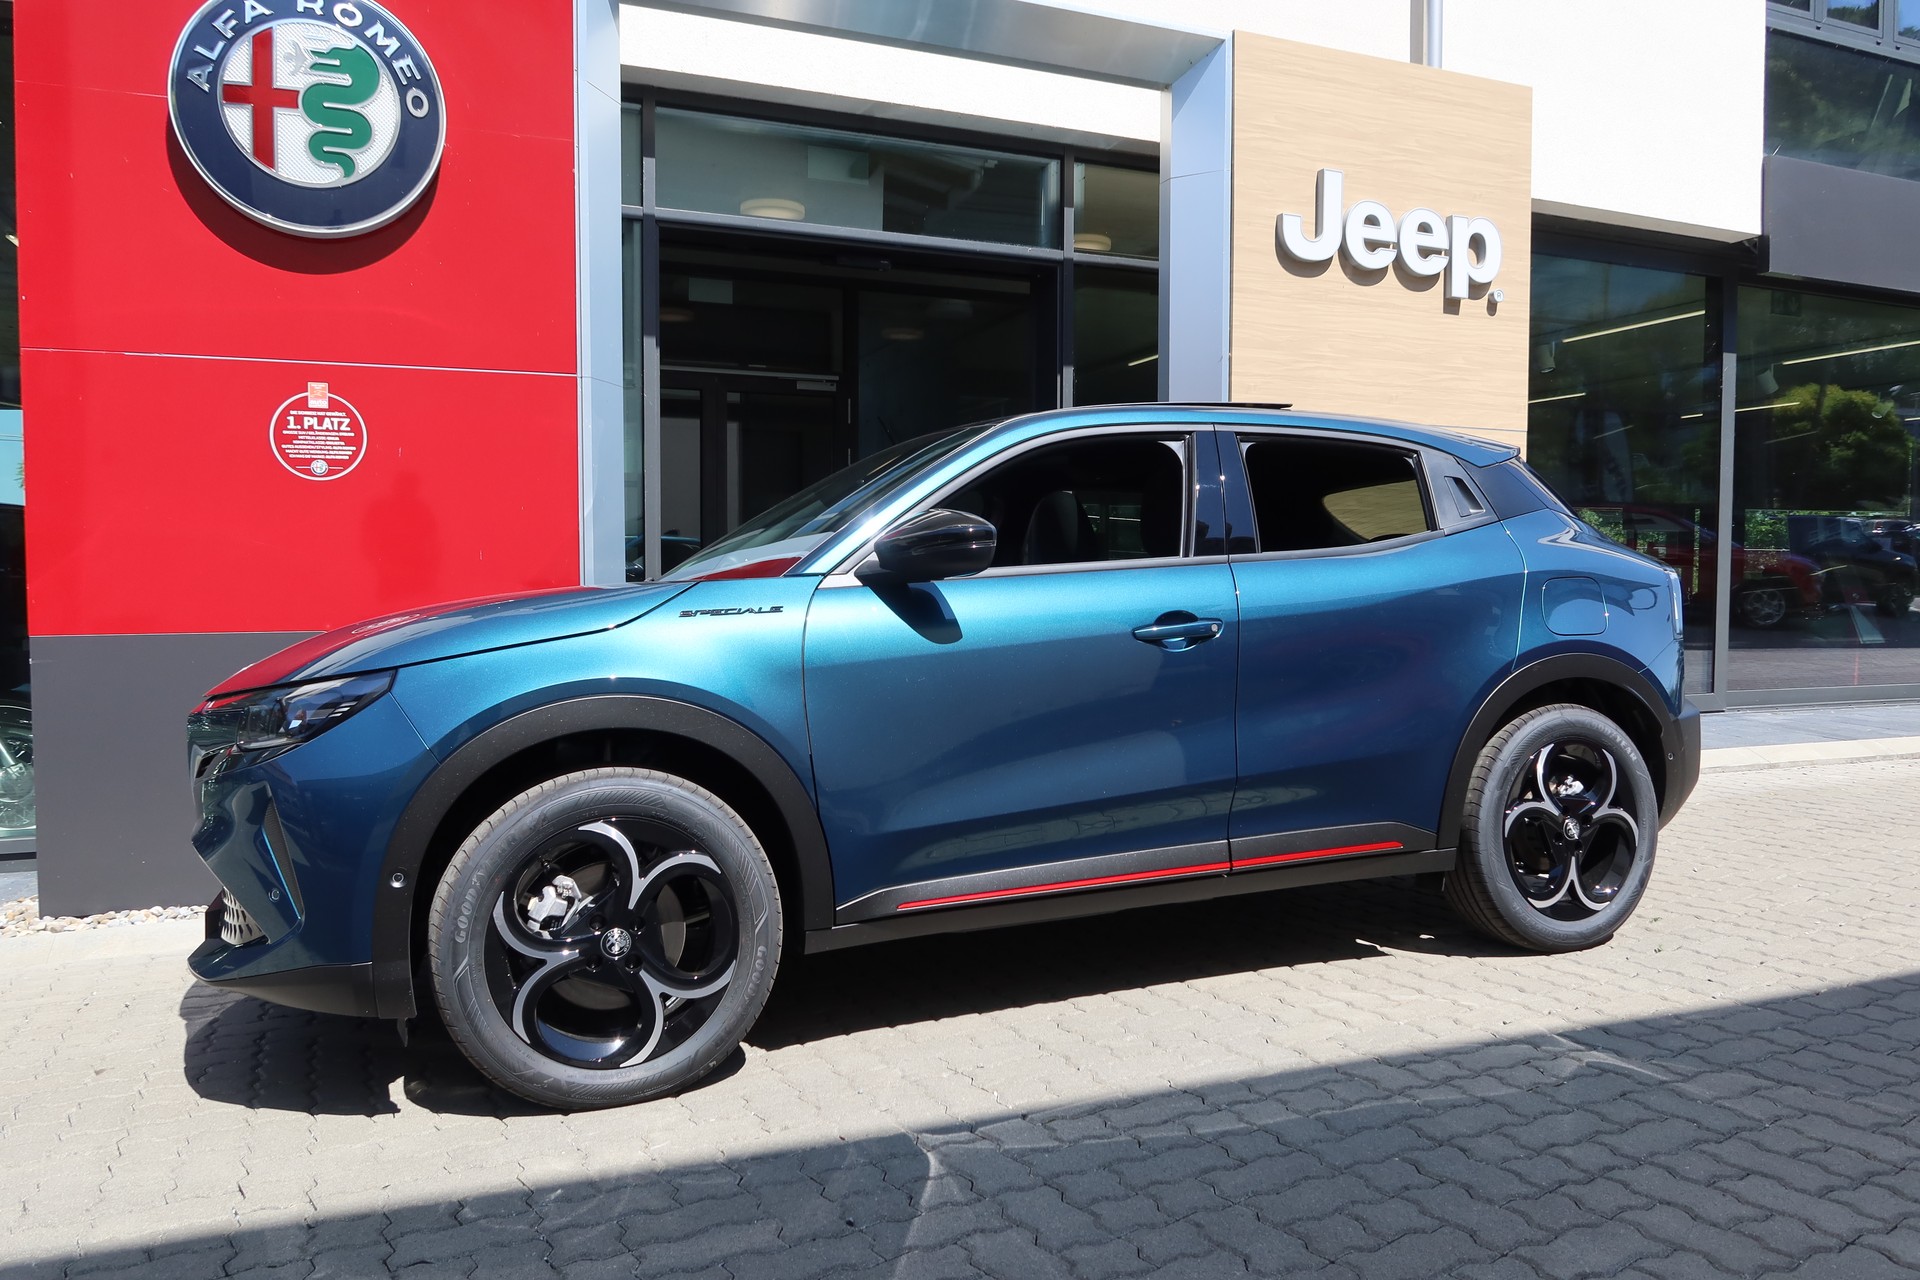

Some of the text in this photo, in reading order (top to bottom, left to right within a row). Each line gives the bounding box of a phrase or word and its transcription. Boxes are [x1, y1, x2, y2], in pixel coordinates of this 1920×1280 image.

[187, 0, 429, 118] ALFA ROMEO
[287, 416, 351, 431] 1. PLATZ
[679, 606, 784, 618] SPECIALE
